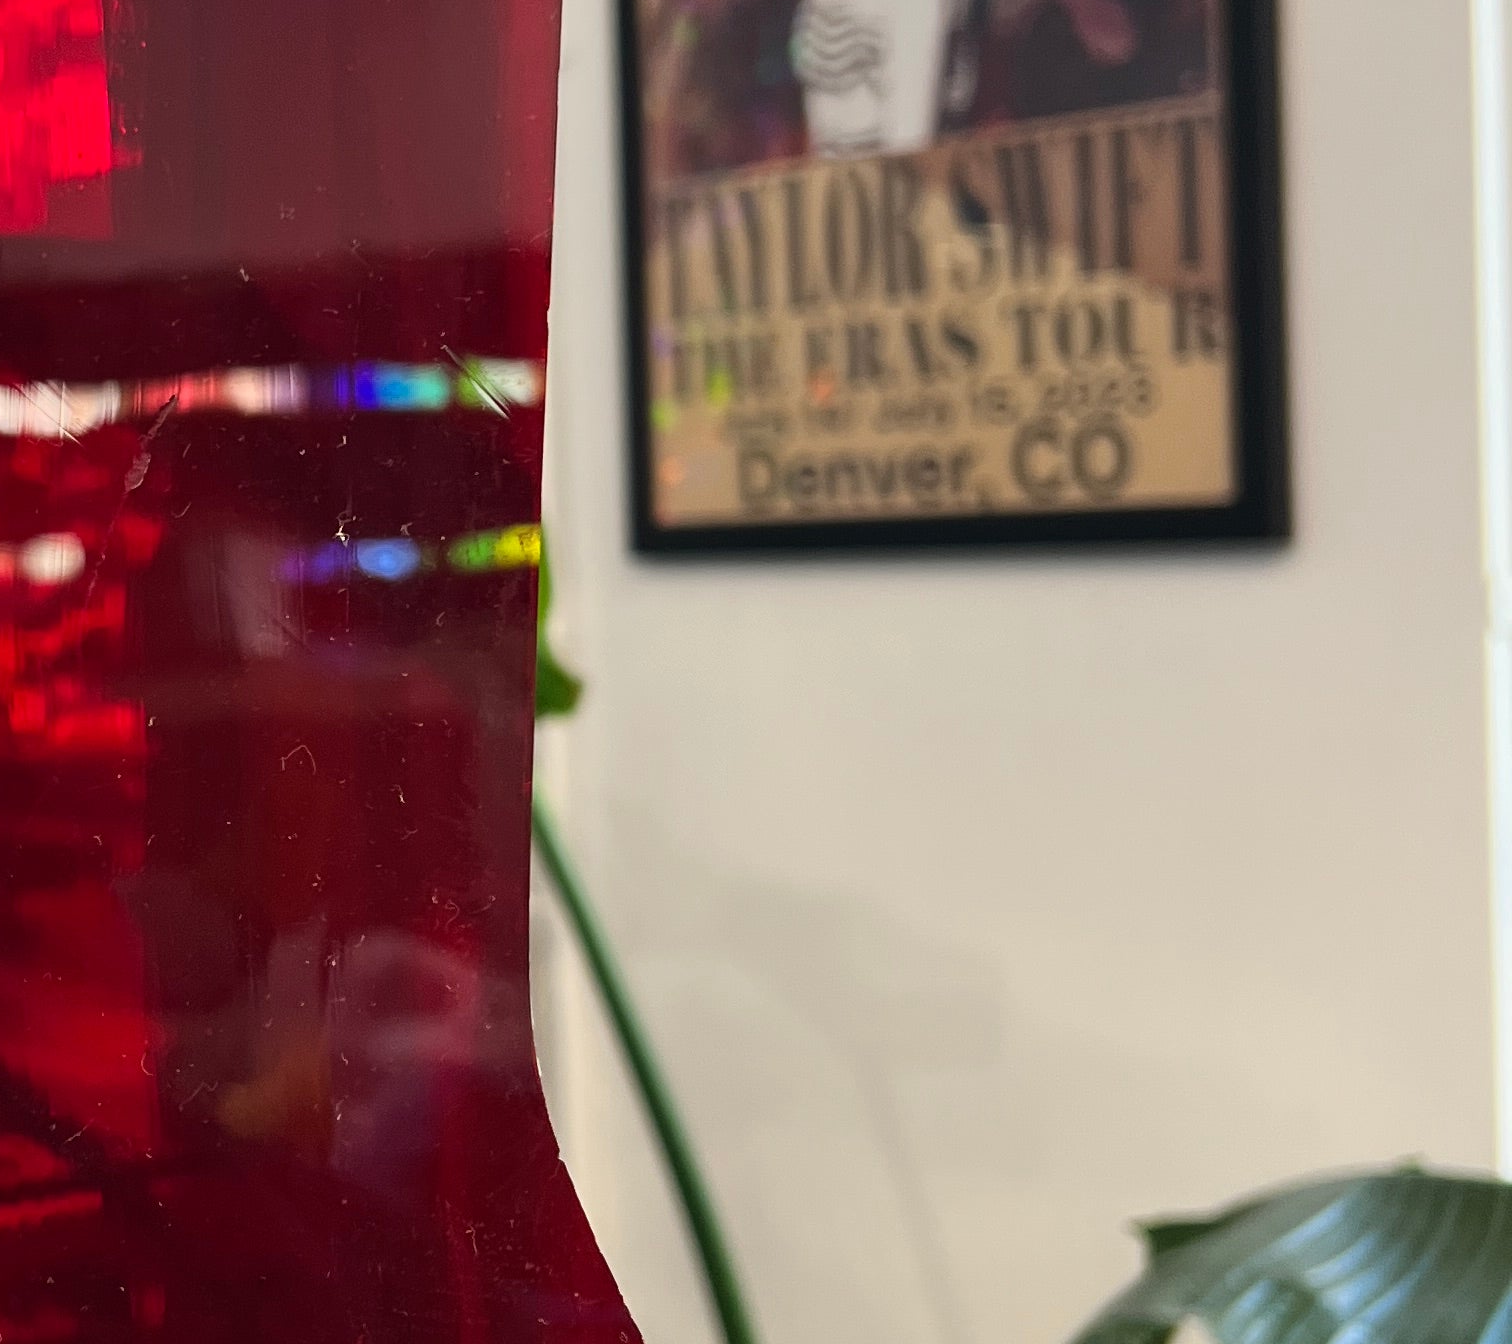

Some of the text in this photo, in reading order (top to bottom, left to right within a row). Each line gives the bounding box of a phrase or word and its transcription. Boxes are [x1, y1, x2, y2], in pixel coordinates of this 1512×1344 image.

[658, 116, 1216, 320] TAYLOR SWIFT
[803, 311, 982, 388] ERAS
[1000, 289, 1226, 373] TOUR
[1009, 416, 1133, 504] CO
